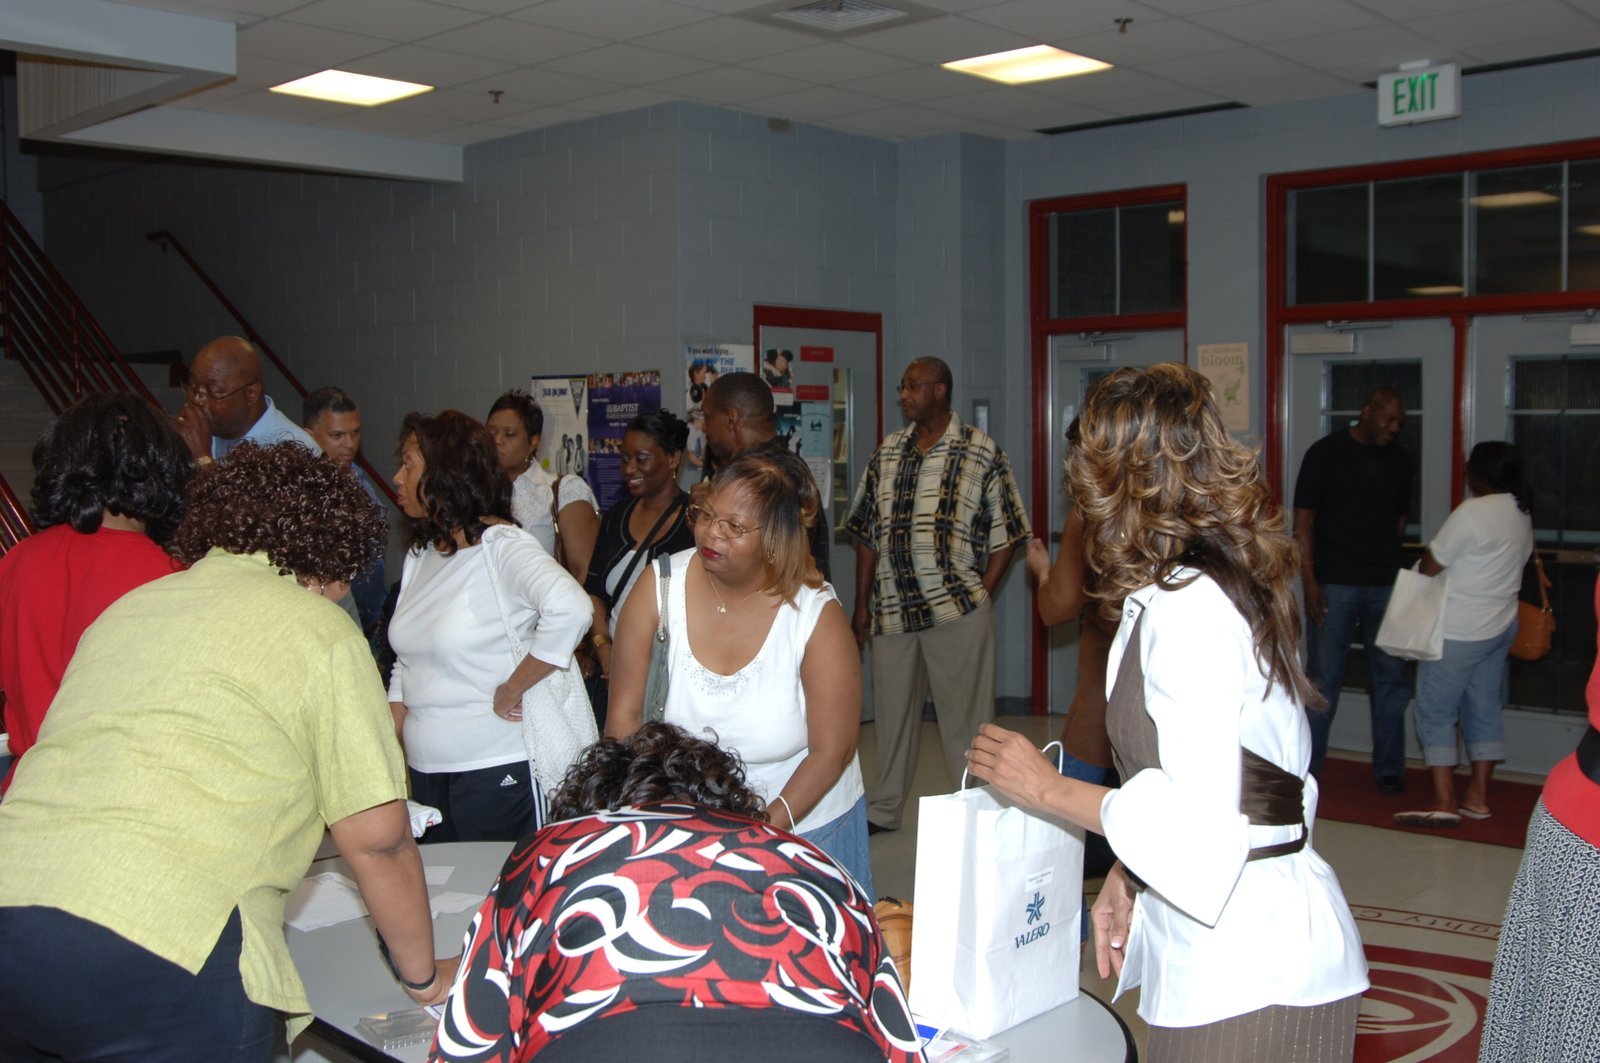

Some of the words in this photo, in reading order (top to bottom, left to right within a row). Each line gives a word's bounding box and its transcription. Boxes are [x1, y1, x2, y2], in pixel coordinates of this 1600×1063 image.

[1394, 73, 1439, 115] EXIT
[720, 357, 736, 365] THE
[1202, 354, 1243, 366] bloom
[613, 403, 640, 412] BAPTIST
[1015, 922, 1050, 949] VALERO
